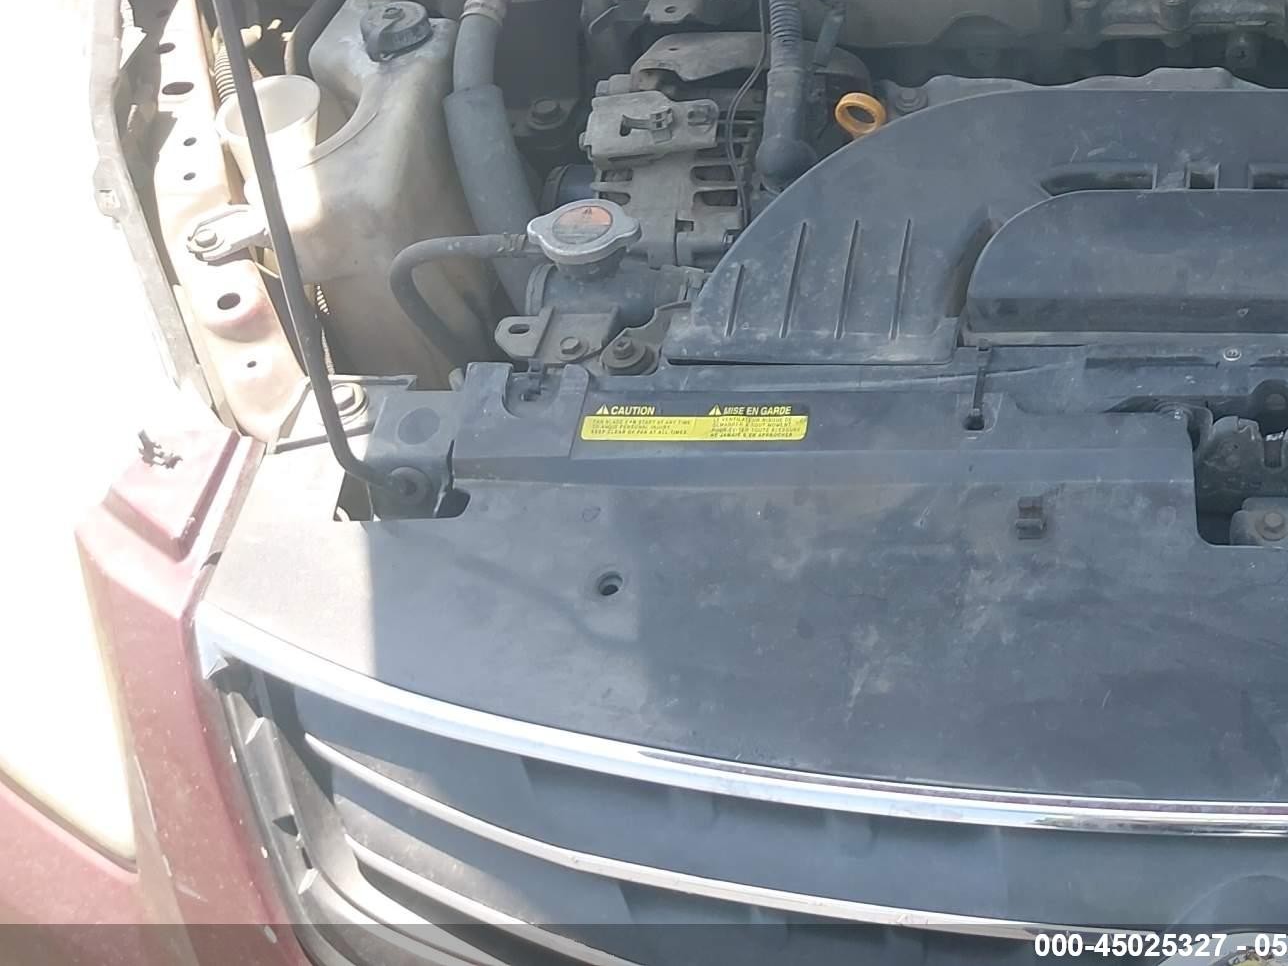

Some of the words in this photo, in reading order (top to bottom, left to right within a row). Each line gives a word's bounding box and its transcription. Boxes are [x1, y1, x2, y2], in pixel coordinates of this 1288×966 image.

[610, 406, 656, 415] CAUTION
[723, 406, 745, 415] MISE
[746, 406, 759, 415] EN
[760, 406, 792, 415] GARDE
